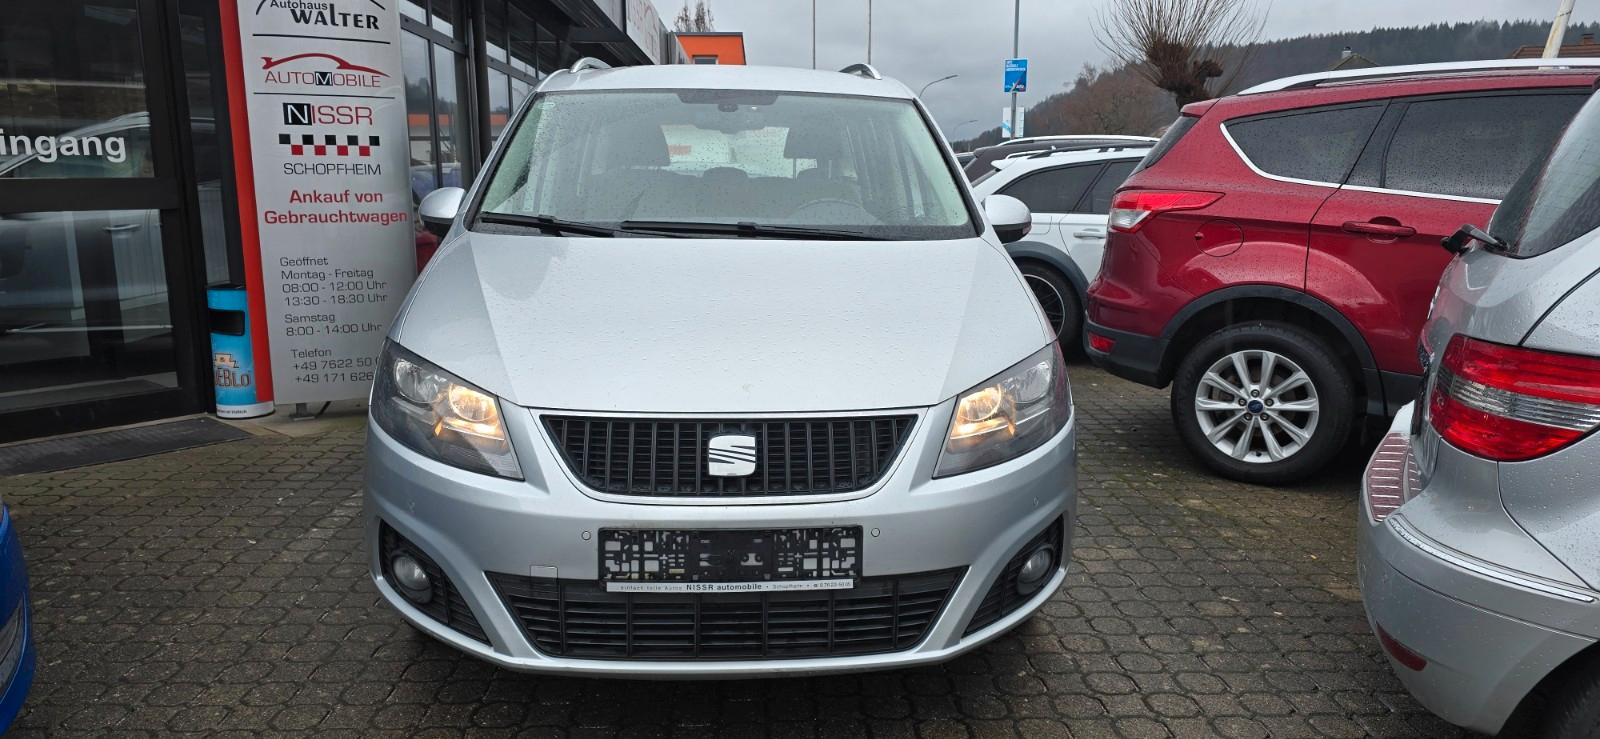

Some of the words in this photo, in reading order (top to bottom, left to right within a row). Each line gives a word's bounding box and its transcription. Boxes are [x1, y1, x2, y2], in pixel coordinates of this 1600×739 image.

[270, 0, 328, 10] Autohaus
[265, 71, 381, 88] AUTOMOBILE
[285, 104, 373, 125] NISSR
[283, 163, 382, 175] SCHOPFHEIM
[289, 189, 350, 204] Ankauf
[354, 192, 383, 203] von
[264, 210, 408, 226] Gebrauchtwagen
[280, 257, 329, 267] Geöffnet
[281, 270, 326, 280] Montag
[335, 269, 374, 279] Freitag
[282, 282, 319, 293] 08:00
[330, 281, 364, 291] 12:00
[366, 280, 387, 290] Uhr
[285, 296, 320, 306] 13:30
[331, 294, 364, 304] 18:30
[367, 293, 388, 303] Uhr
[284, 313, 336, 323] Samstag
[286, 326, 314, 336] 8:00
[325, 324, 359, 334] 14:00
[361, 323, 382, 333] Uhr
[290, 348, 332, 358] Telefon
[292, 360, 317, 370] +49
[322, 358, 353, 369] 7622
[296, 373, 319, 383] +49
[323, 372, 345, 383] 171
[716, 583, 762, 591] automobile
